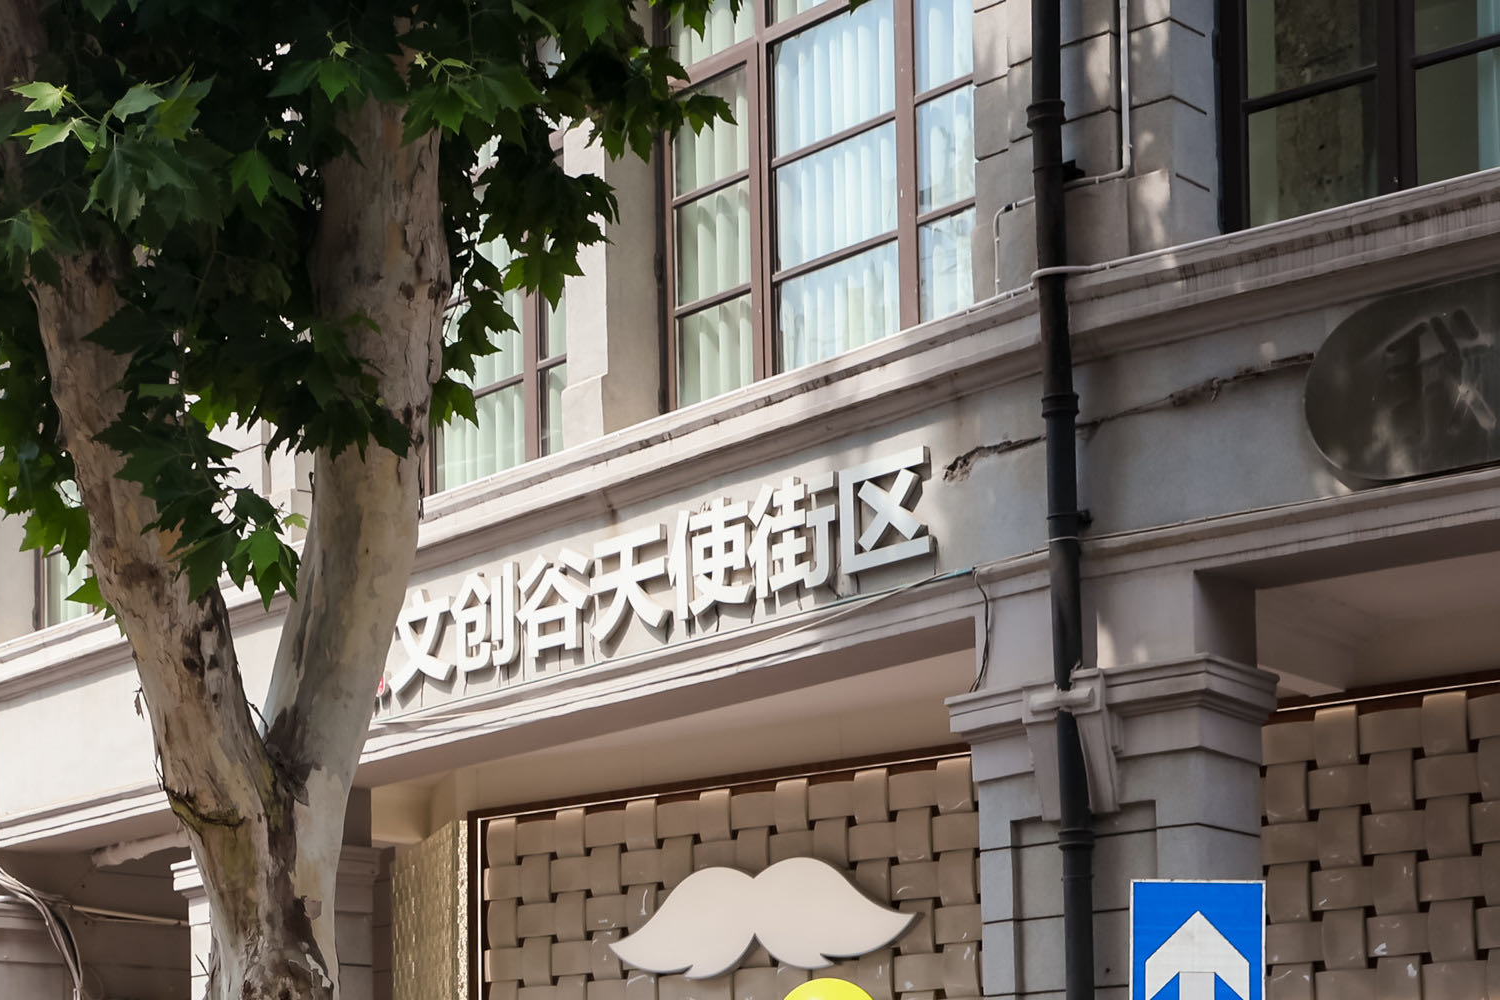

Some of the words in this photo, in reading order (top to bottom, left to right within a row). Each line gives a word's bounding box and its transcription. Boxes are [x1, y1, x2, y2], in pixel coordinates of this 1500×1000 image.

[387, 445, 936, 697] 文创谷天使街区
